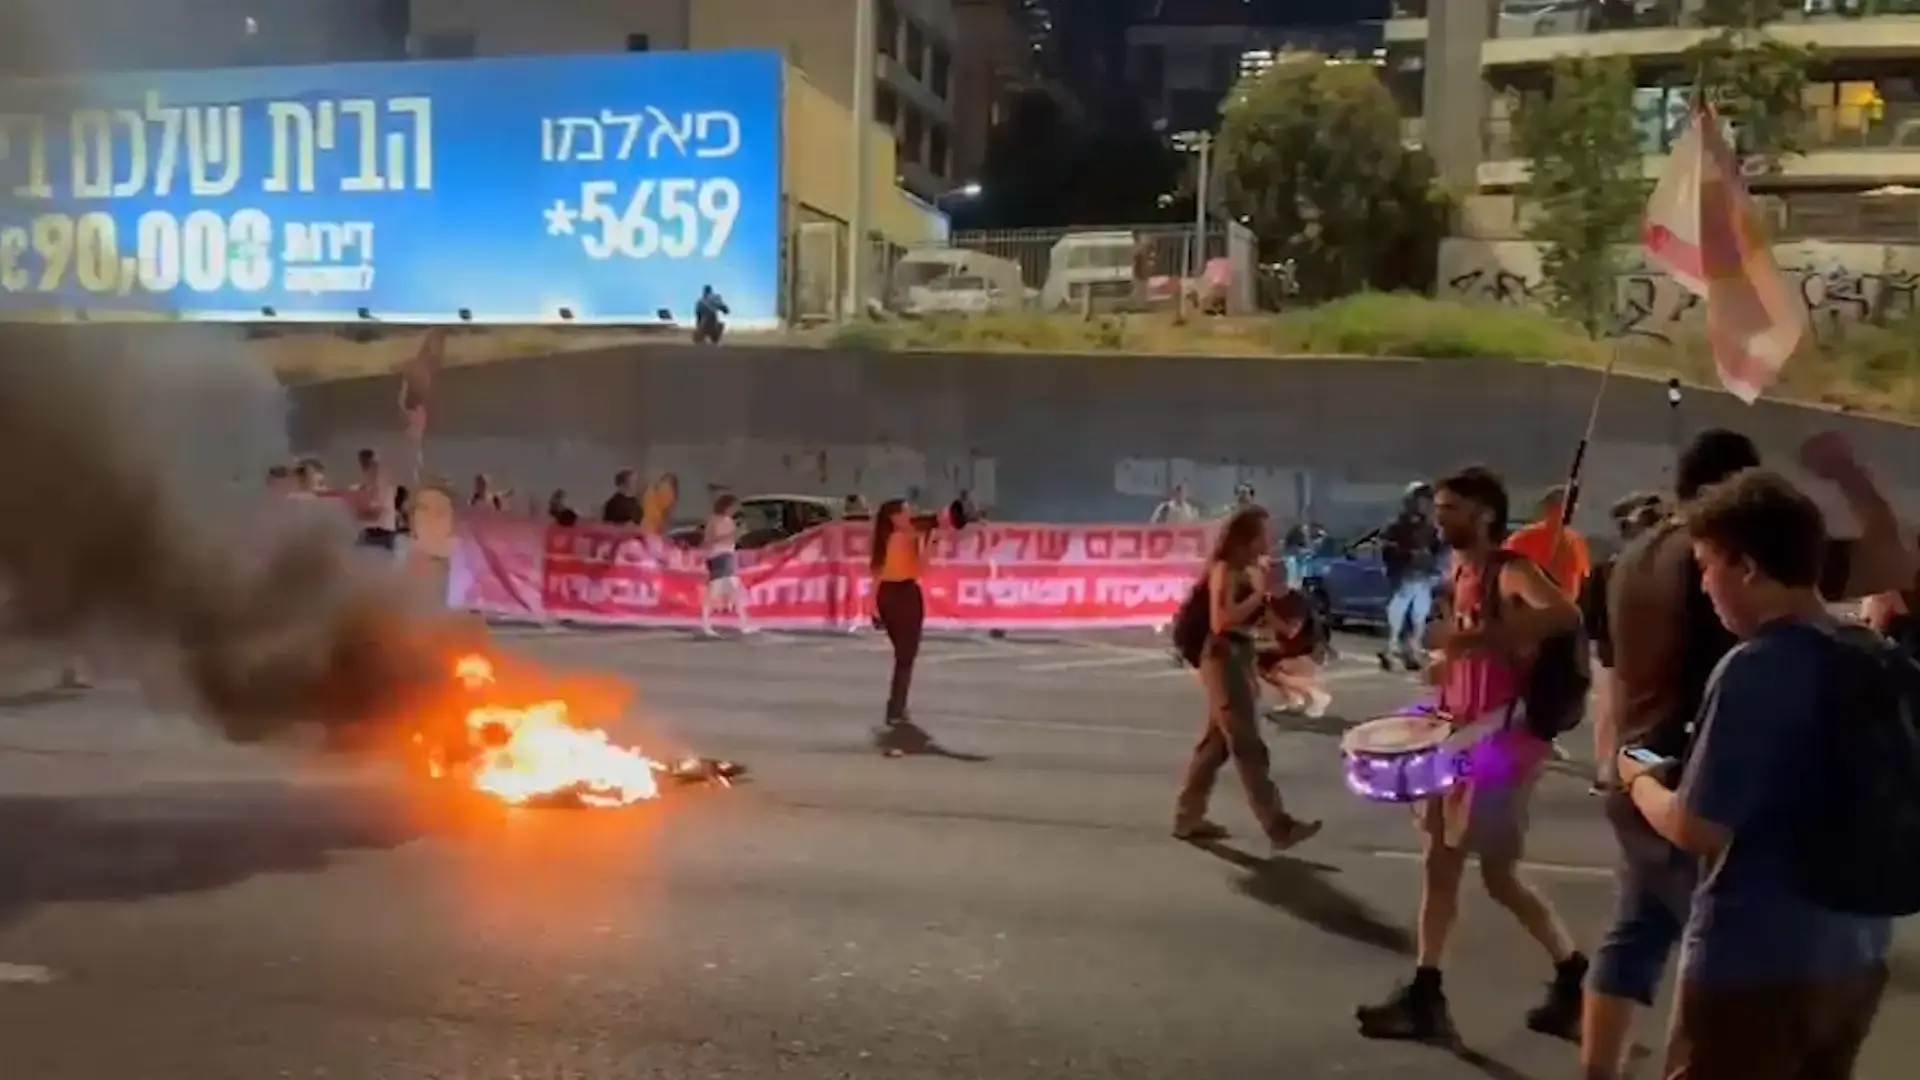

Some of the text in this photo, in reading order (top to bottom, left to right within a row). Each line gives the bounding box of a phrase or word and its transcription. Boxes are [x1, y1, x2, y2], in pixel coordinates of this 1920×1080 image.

[71, 90, 242, 199] שלכם
[262, 96, 432, 193] הבית
[541, 105, 741, 162] פאלמו
